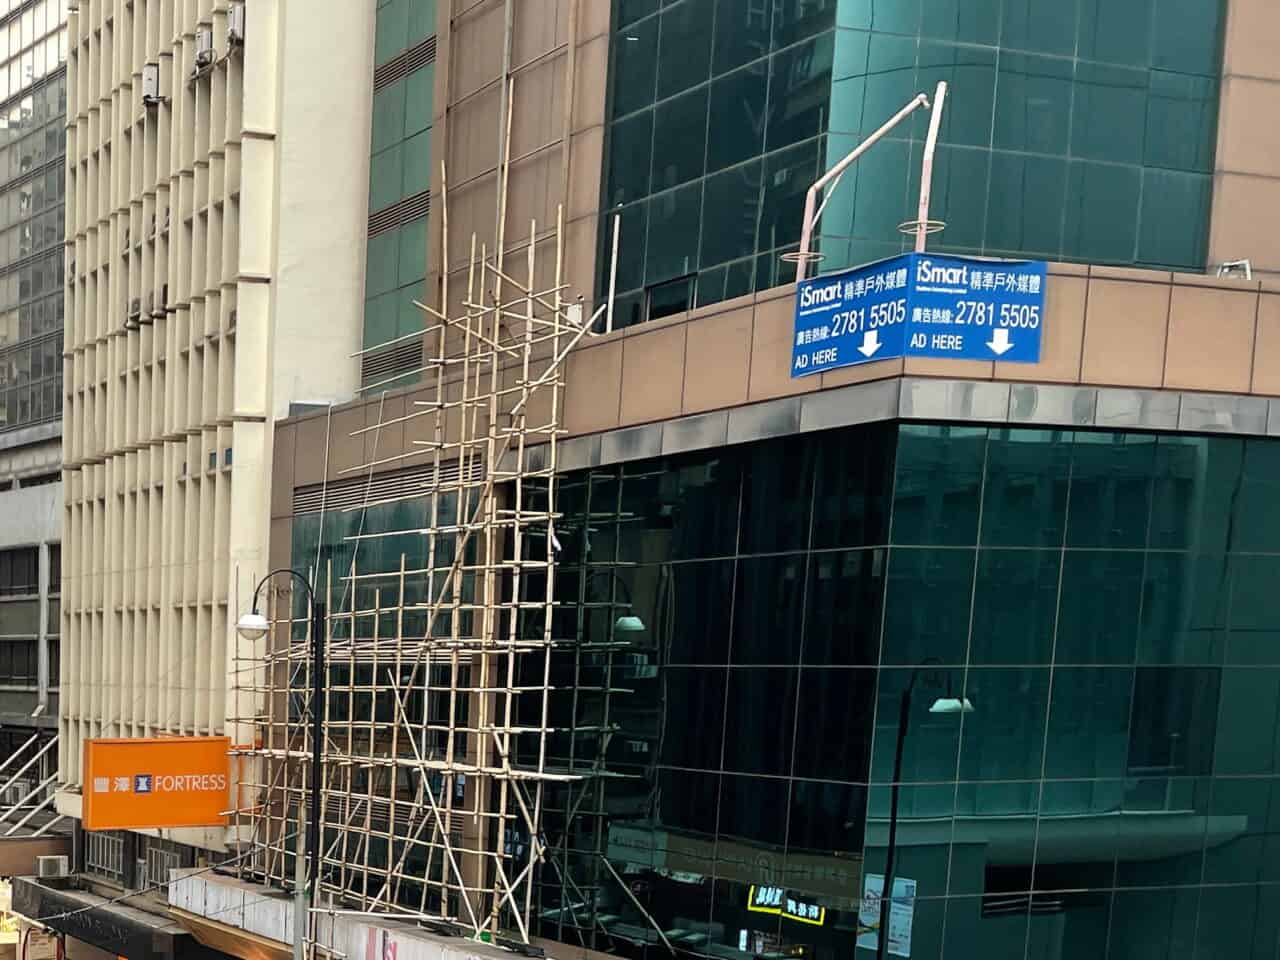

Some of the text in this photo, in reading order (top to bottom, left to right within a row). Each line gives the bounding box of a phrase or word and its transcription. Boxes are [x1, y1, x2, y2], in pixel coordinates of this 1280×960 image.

[917, 261, 967, 284] iSmart
[800, 282, 841, 307] iSmart
[831, 308, 865, 337] 2781
[869, 299, 906, 328] 5505
[955, 301, 994, 326] 2781
[1000, 304, 1039, 328] 5505
[910, 333, 963, 350] AD HERE
[795, 347, 838, 368] AD HERE
[155, 774, 226, 792] FORTRESS
